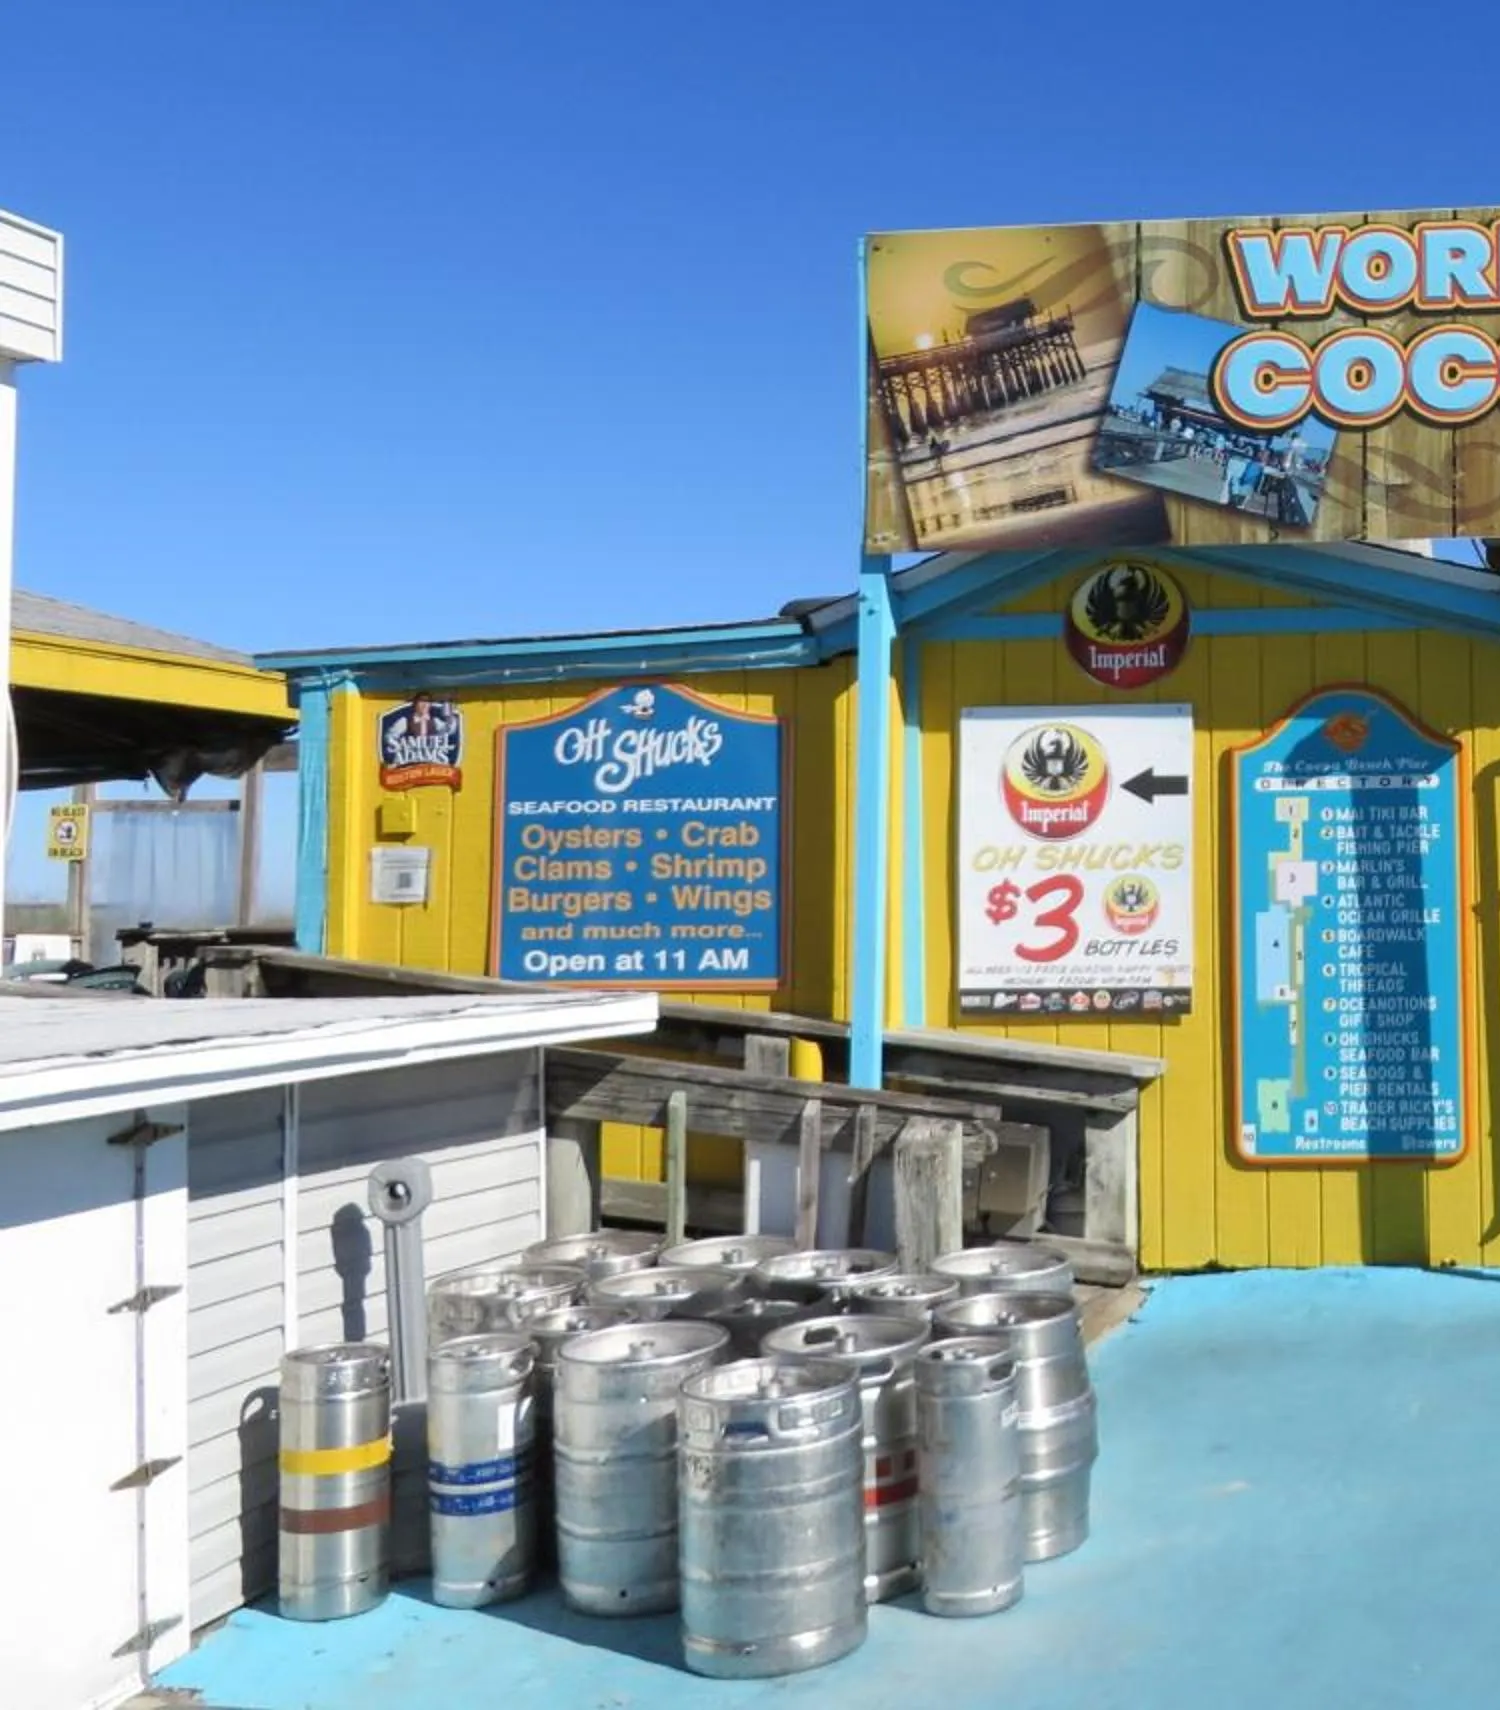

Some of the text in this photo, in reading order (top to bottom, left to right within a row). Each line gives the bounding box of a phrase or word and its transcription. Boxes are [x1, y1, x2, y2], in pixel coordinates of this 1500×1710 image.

[1088, 643, 1166, 680] Imperial
[386, 733, 455, 753] SAMUEL
[395, 746, 449, 765] ADAMS
[508, 797, 777, 815] SEAFOOD RESTAURANT
[1370, 806, 1396, 820] TIKI
[1400, 805, 1428, 820] BAR
[1020, 800, 1090, 833] Imperial
[521, 821, 760, 854] Oysters Crab
[1337, 824, 1367, 838] BAIT
[1374, 825, 1383, 838] &
[1390, 824, 1441, 838] TACKLE
[1337, 840, 1429, 855] FISHING PIER
[971, 844, 1185, 872] OH SHUCKS
[1337, 859, 1406, 873] MARLIN'S
[513, 853, 767, 883] Clams Shrimp
[1337, 876, 1365, 890] BAR
[1371, 875, 1382, 889] &
[508, 885, 772, 918] Burgers Wings
[1338, 893, 1405, 908] ATLANTIC
[985, 873, 1085, 963] $3
[1338, 908, 1441, 924] OCEAN GRILLE
[520, 923, 573, 941] and
[582, 922, 661, 940] much
[1337, 927, 1425, 941] BOARDWALK
[524, 948, 750, 977] Open at 11 AM
[1340, 962, 1407, 977] TROPICAL
[1340, 978, 1405, 994] THREADS
[1339, 995, 1438, 1011] OCEANOTIONS
[1339, 1012, 1415, 1028] GIFT SHOP
[1339, 1031, 1359, 1046] OH
[1340, 1045, 1440, 1061] SEAFOOD BAR
[1340, 1066, 1406, 1080] SEADOGS
[1414, 1066, 1424, 1080] &
[1340, 1081, 1439, 1097] PIER RENTALS
[1341, 1100, 1396, 1115] TRADER
[1400, 1098, 1454, 1114] RICKY'S
[1341, 1115, 1457, 1131] BEACH SUPPLIES
[1295, 1136, 1366, 1151] Restrooms
